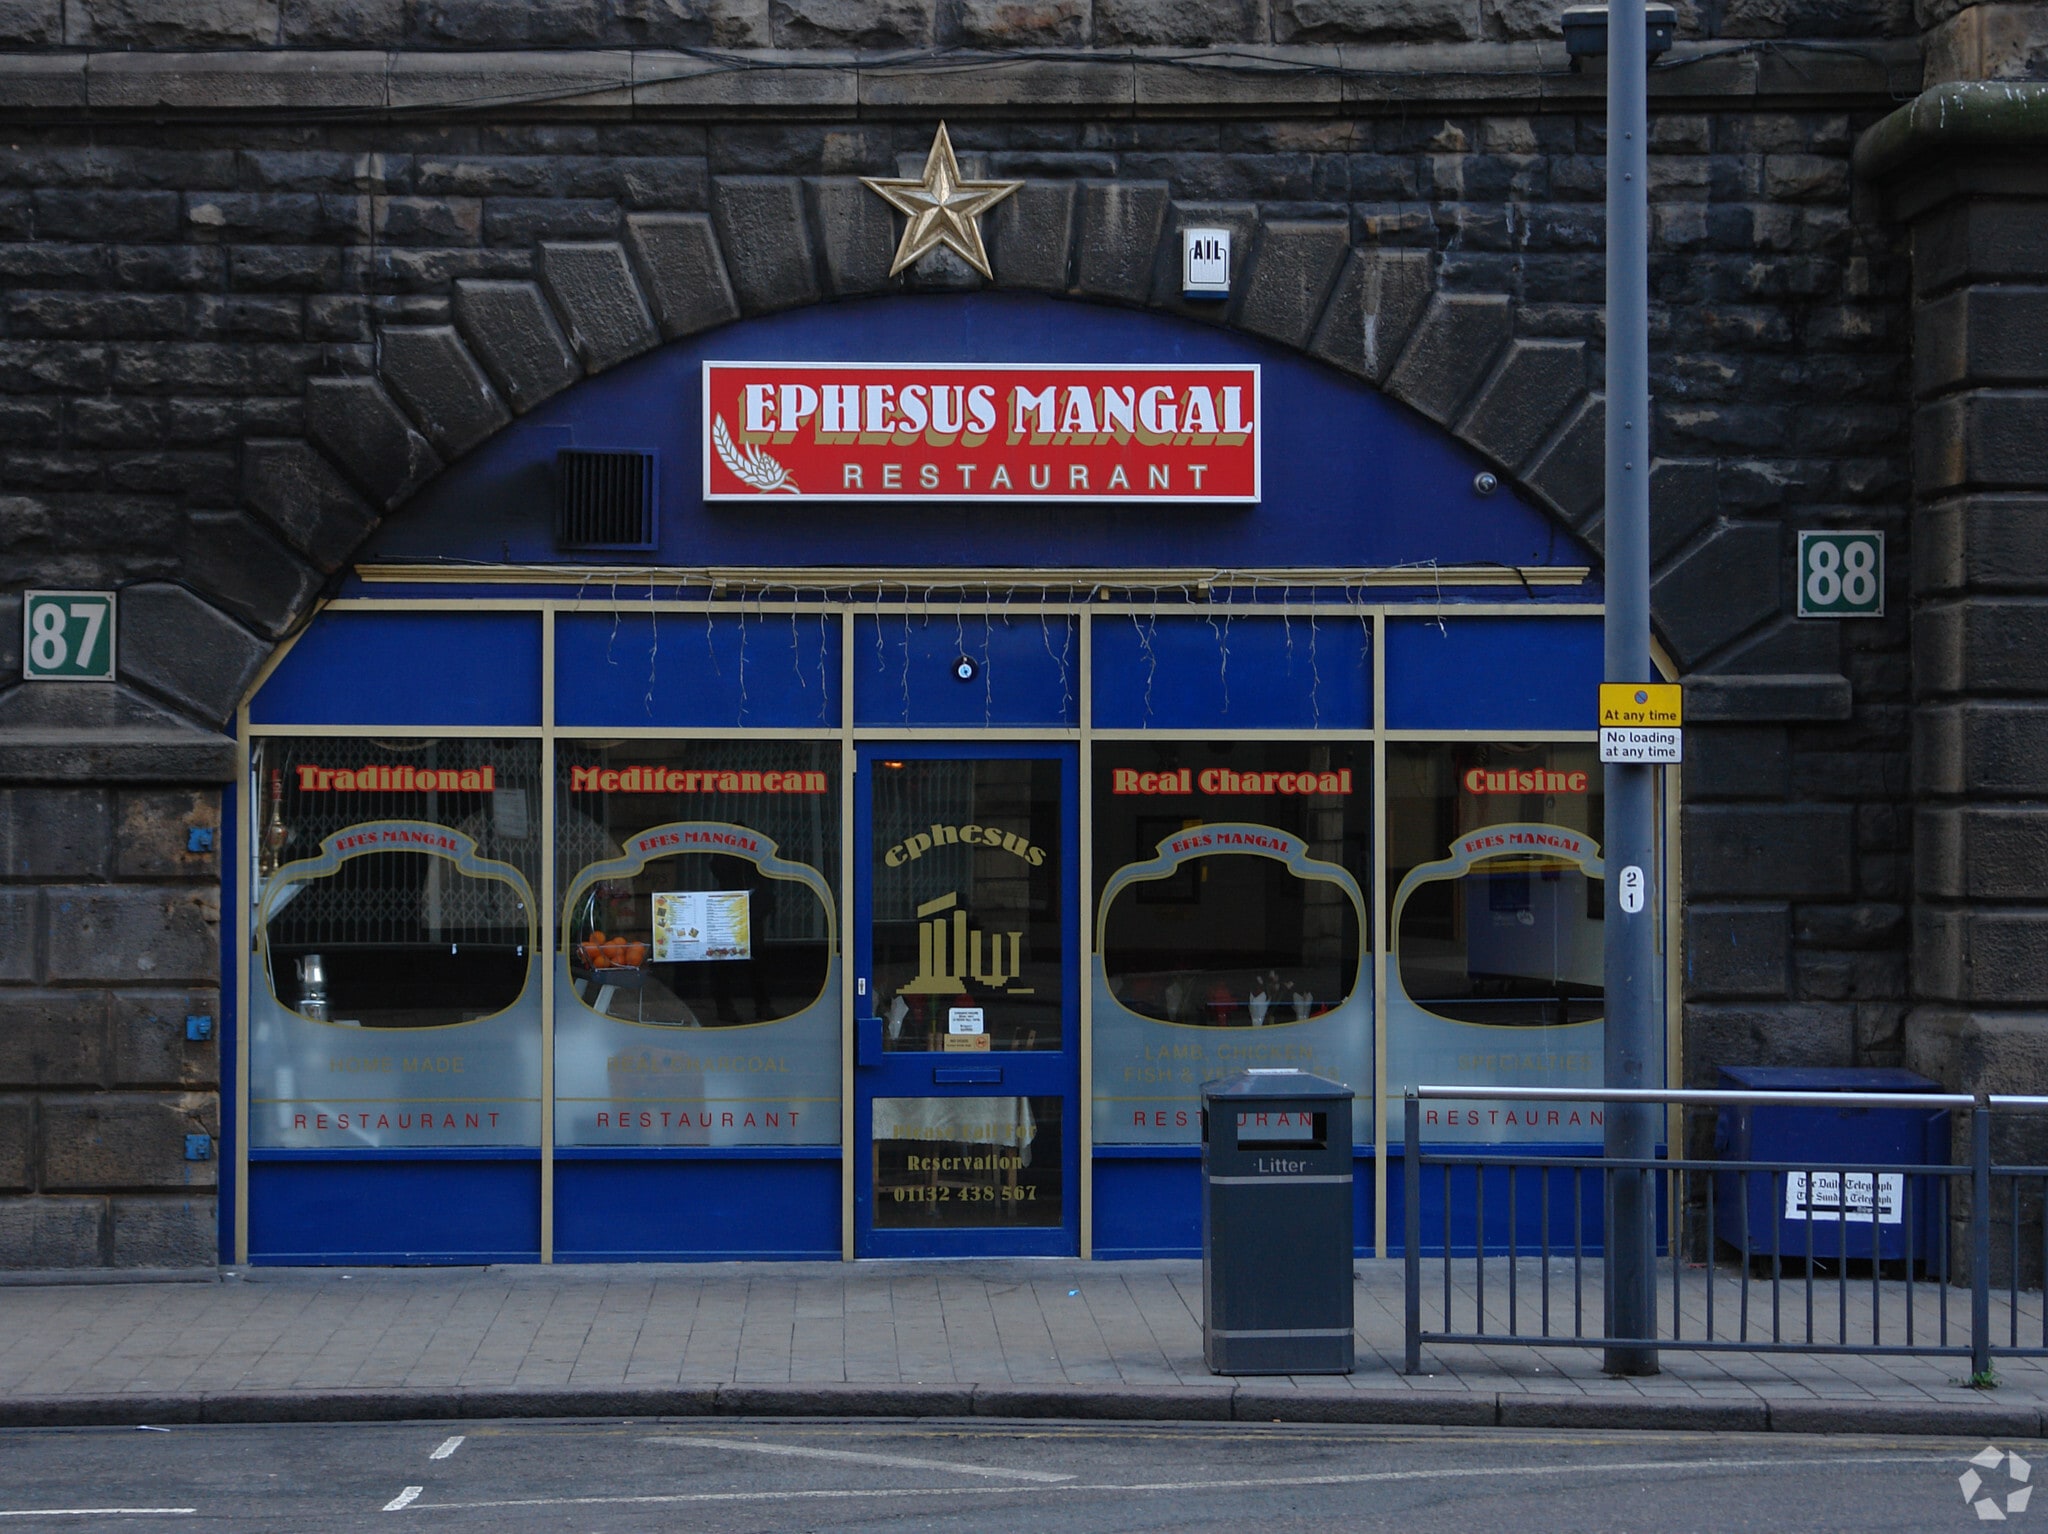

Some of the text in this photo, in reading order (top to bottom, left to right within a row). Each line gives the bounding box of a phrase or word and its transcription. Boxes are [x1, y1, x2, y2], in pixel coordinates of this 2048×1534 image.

[738, 384, 1254, 446] EPHESUS MANGAL
[842, 463, 1210, 491] RESTAURANT
[1806, 541, 1878, 605] 88
[30, 602, 107, 669] 87
[1605, 710, 1677, 723] At any time
[1607, 732, 1675, 745] No loading
[1605, 746, 1676, 759] at any time
[297, 765, 496, 792] Traditional
[571, 765, 828, 794] Mediterranean
[1112, 768, 1353, 795] Real Charcoal
[1464, 767, 1588, 795] Cuisine
[336, 830, 458, 852] EFES MANGAL
[639, 831, 759, 853] EFES MANGAL
[884, 823, 1047, 868] ephesus
[1171, 833, 1290, 854] EFES MANGAL
[1465, 833, 1581, 854] EFES MANGAL
[329, 1056, 465, 1073] HOME MADE
[606, 1056, 791, 1073] REAL CHARCOAL
[1457, 1055, 1594, 1073] SPECIALTIES
[1124, 1066, 1173, 1083] FISH
[1181, 1068, 1194, 1083] &
[293, 1113, 500, 1130] RESTAURANT
[597, 1112, 799, 1128] RESTAURANT
[1426, 1110, 1603, 1126] RESTAURAN
[893, 1124, 956, 1140] Please
[907, 1154, 1023, 1171] Reservation
[1258, 1158, 1307, 1173] Litter
[1797, 1178, 1816, 1188] Te
[1819, 1178, 1841, 1190] Dail
[893, 1185, 1037, 1202] 01132 438 567
